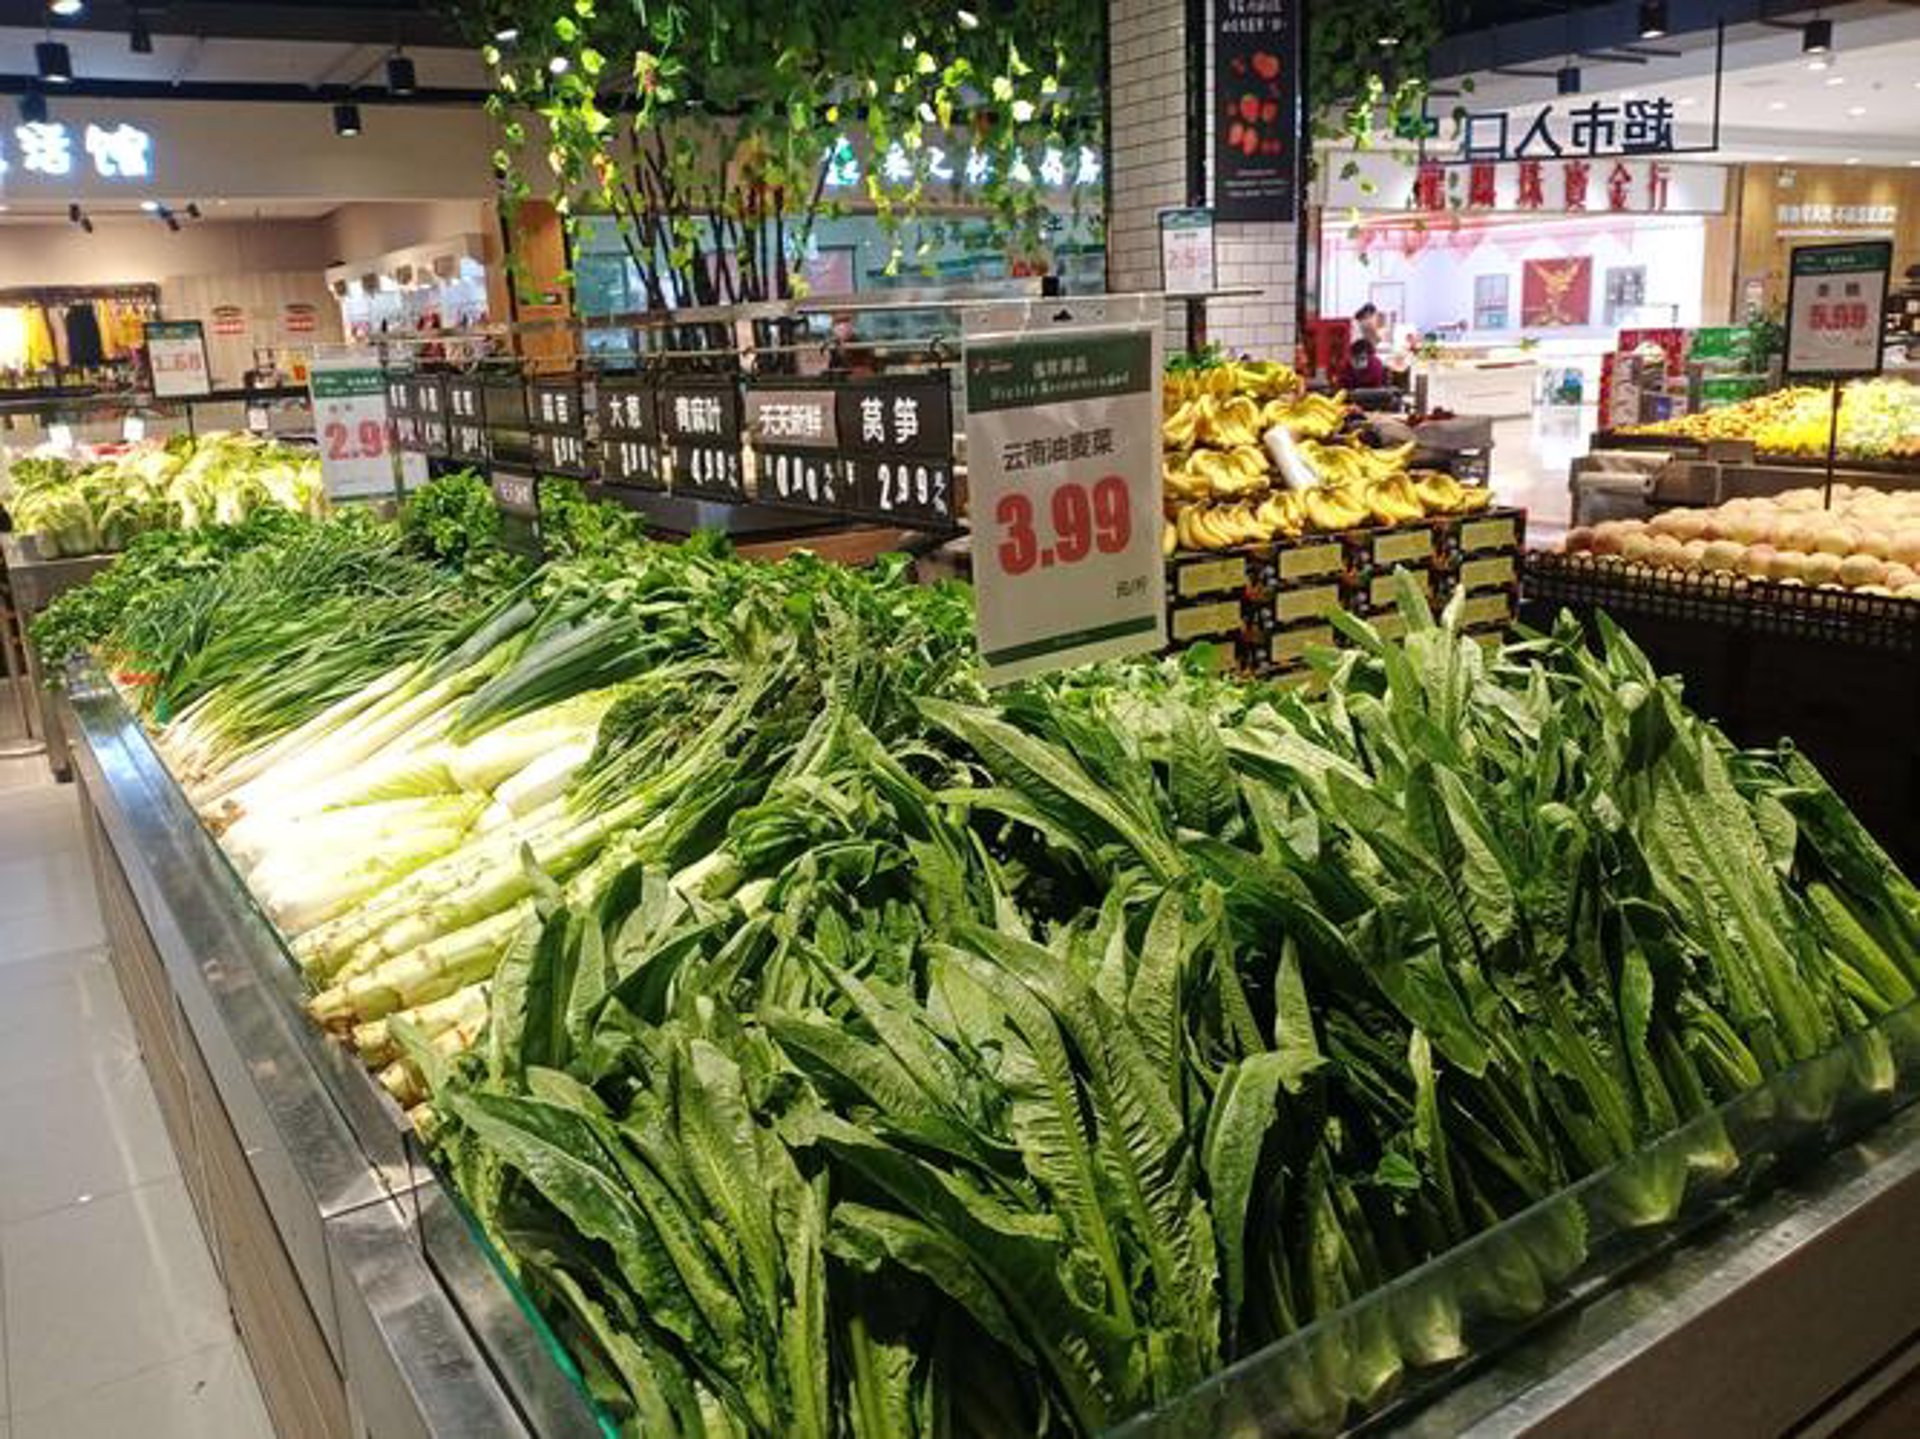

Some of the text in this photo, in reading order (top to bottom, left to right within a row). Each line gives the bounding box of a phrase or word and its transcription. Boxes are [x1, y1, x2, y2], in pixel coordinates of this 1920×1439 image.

[0, 121, 152, 177] 活馆
[859, 396, 920, 444] 莴笋
[1001, 428, 1115, 472] 云南油麦菜
[996, 473, 1132, 577] 3.99
